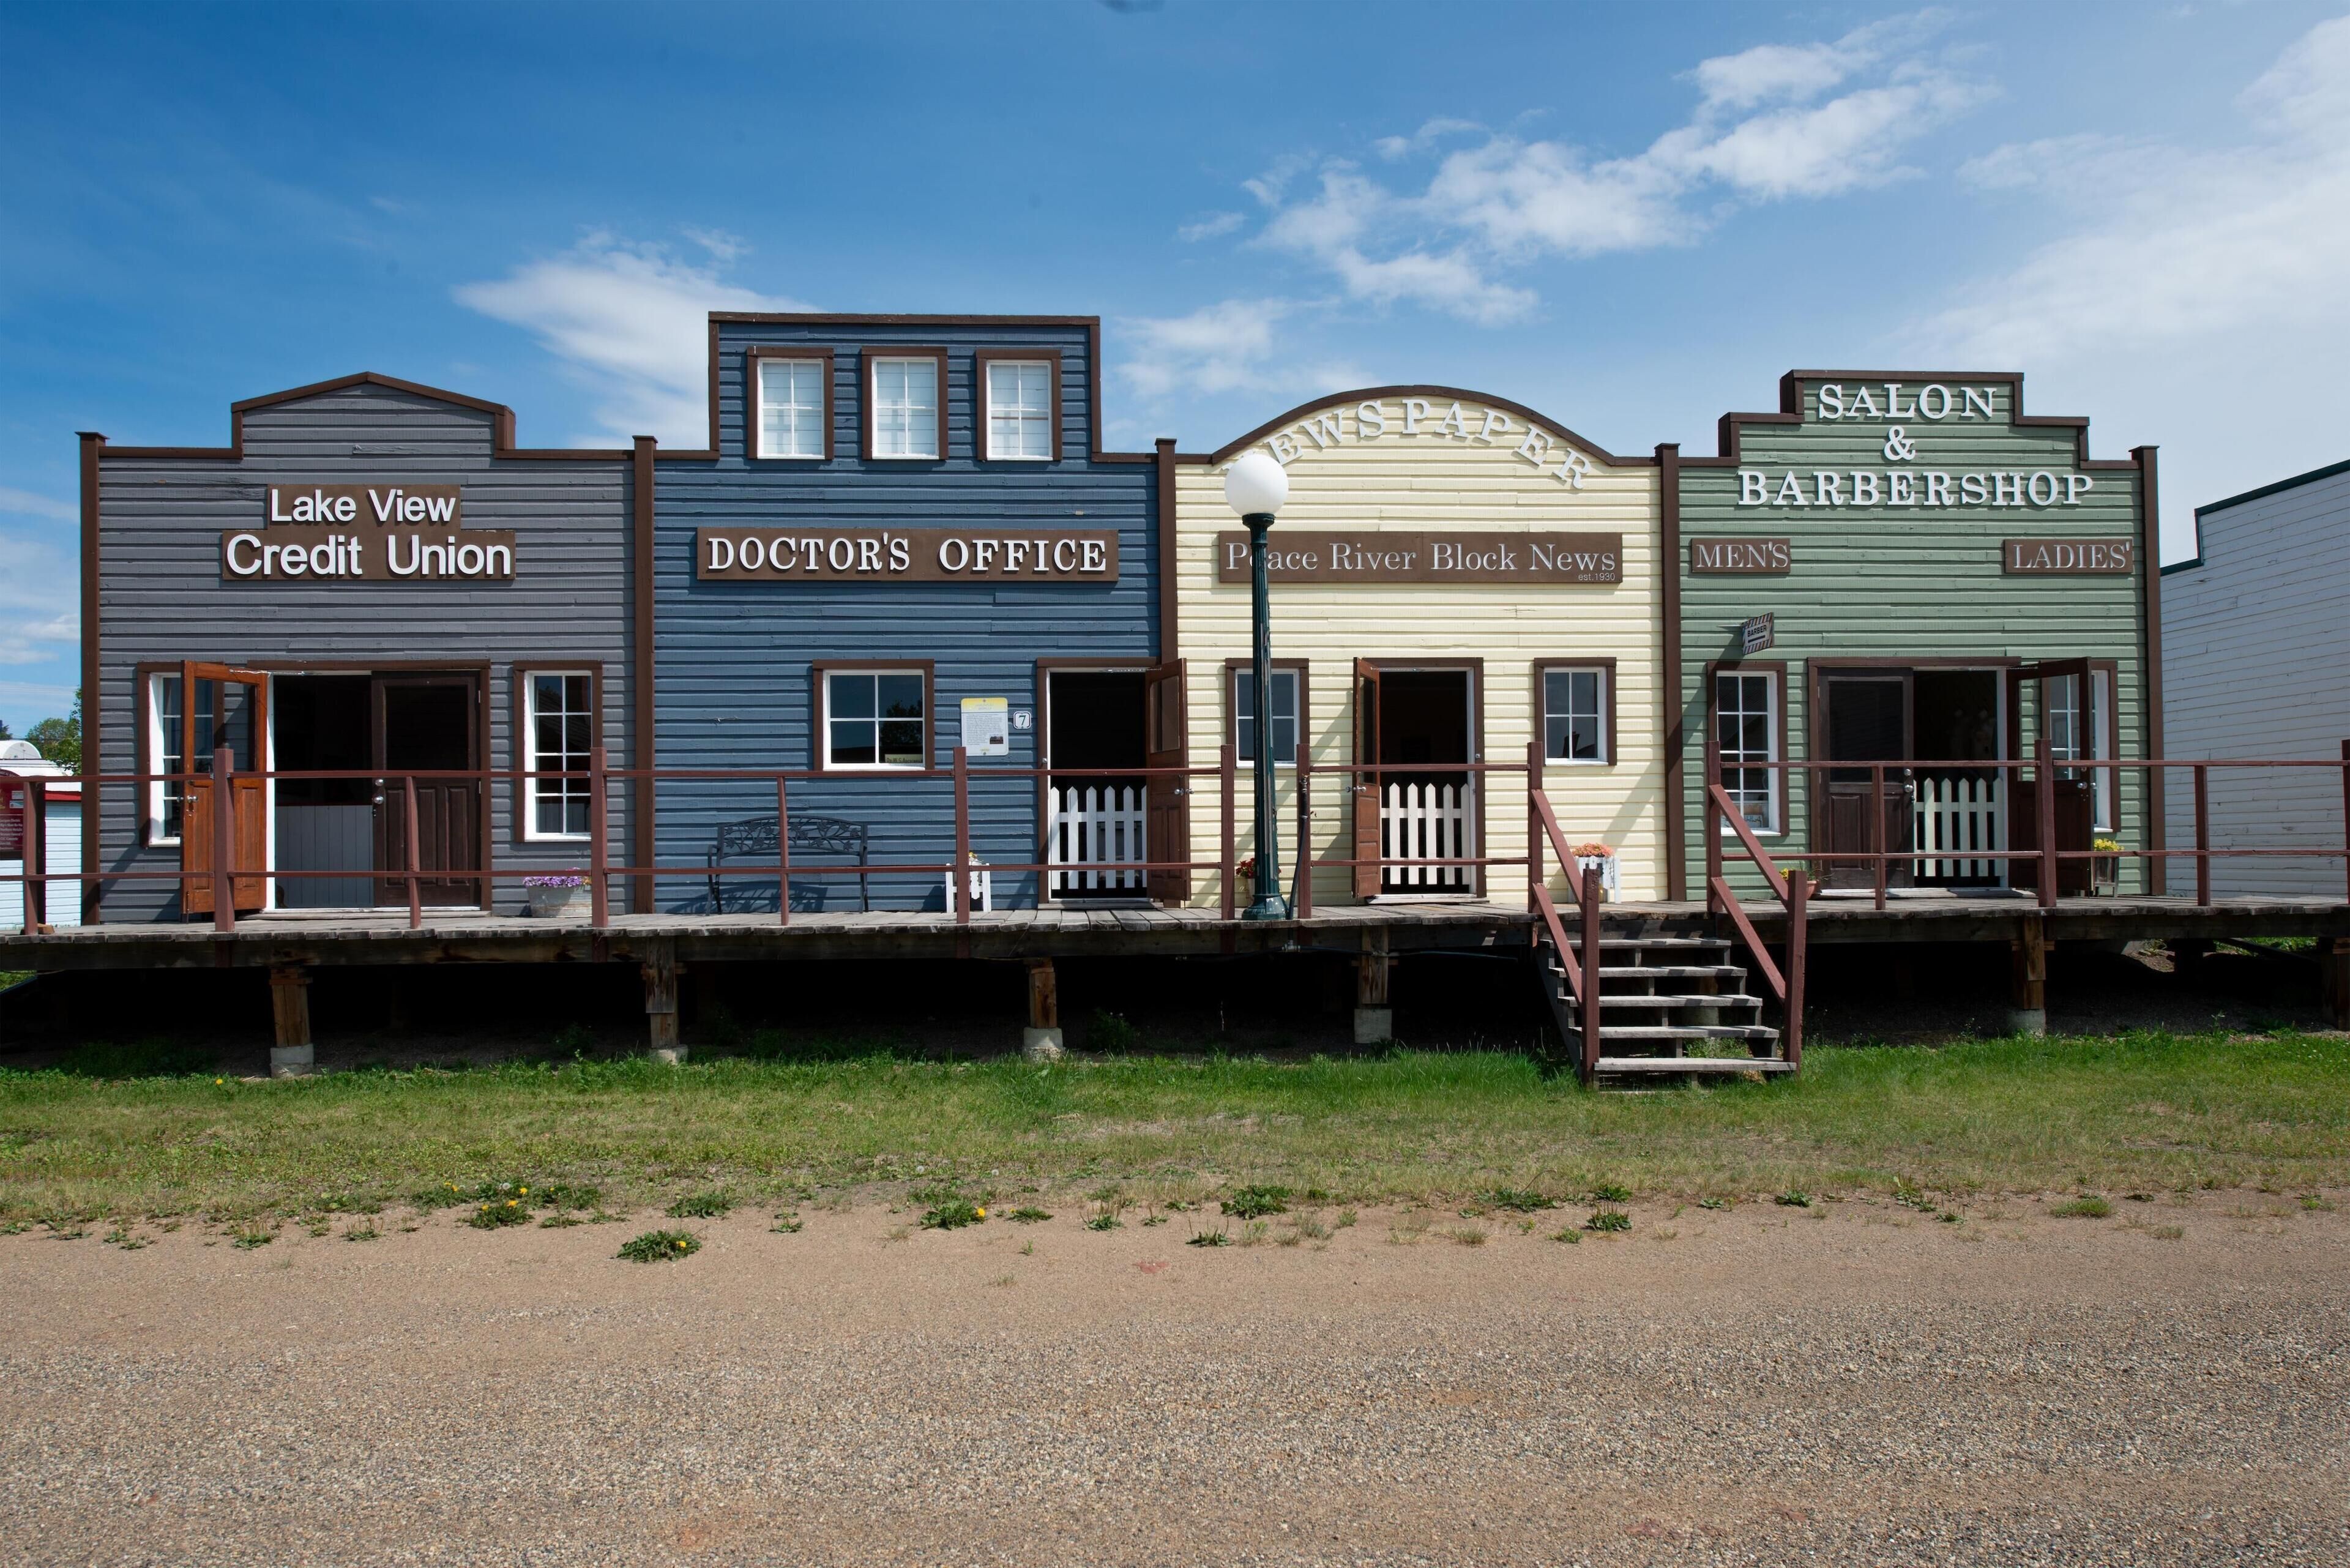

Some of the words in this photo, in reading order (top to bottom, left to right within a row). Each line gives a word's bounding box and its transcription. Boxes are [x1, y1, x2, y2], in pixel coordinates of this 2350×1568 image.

[1819, 384, 1997, 419] SALON
[1222, 399, 1592, 490] EWSPAPER
[1884, 425, 1916, 461] &
[271, 489, 356, 521] Lake
[368, 488, 456, 521] View
[1738, 471, 2094, 506] BARBERSHOP
[226, 534, 363, 575] Credit
[388, 534, 510, 575] Union
[707, 532, 911, 570] DOCTOR'S
[939, 538, 1107, 572] OFFICE
[1225, 542, 1318, 570] Pace
[1329, 542, 1417, 570] River
[1431, 543, 1518, 571] Block
[1528, 543, 1616, 572] News
[1696, 541, 1788, 568] MEN'S
[2013, 541, 2130, 569] LADIES'
[1747, 625, 1767, 637] BARBER
[1018, 715, 1026, 726] 7
